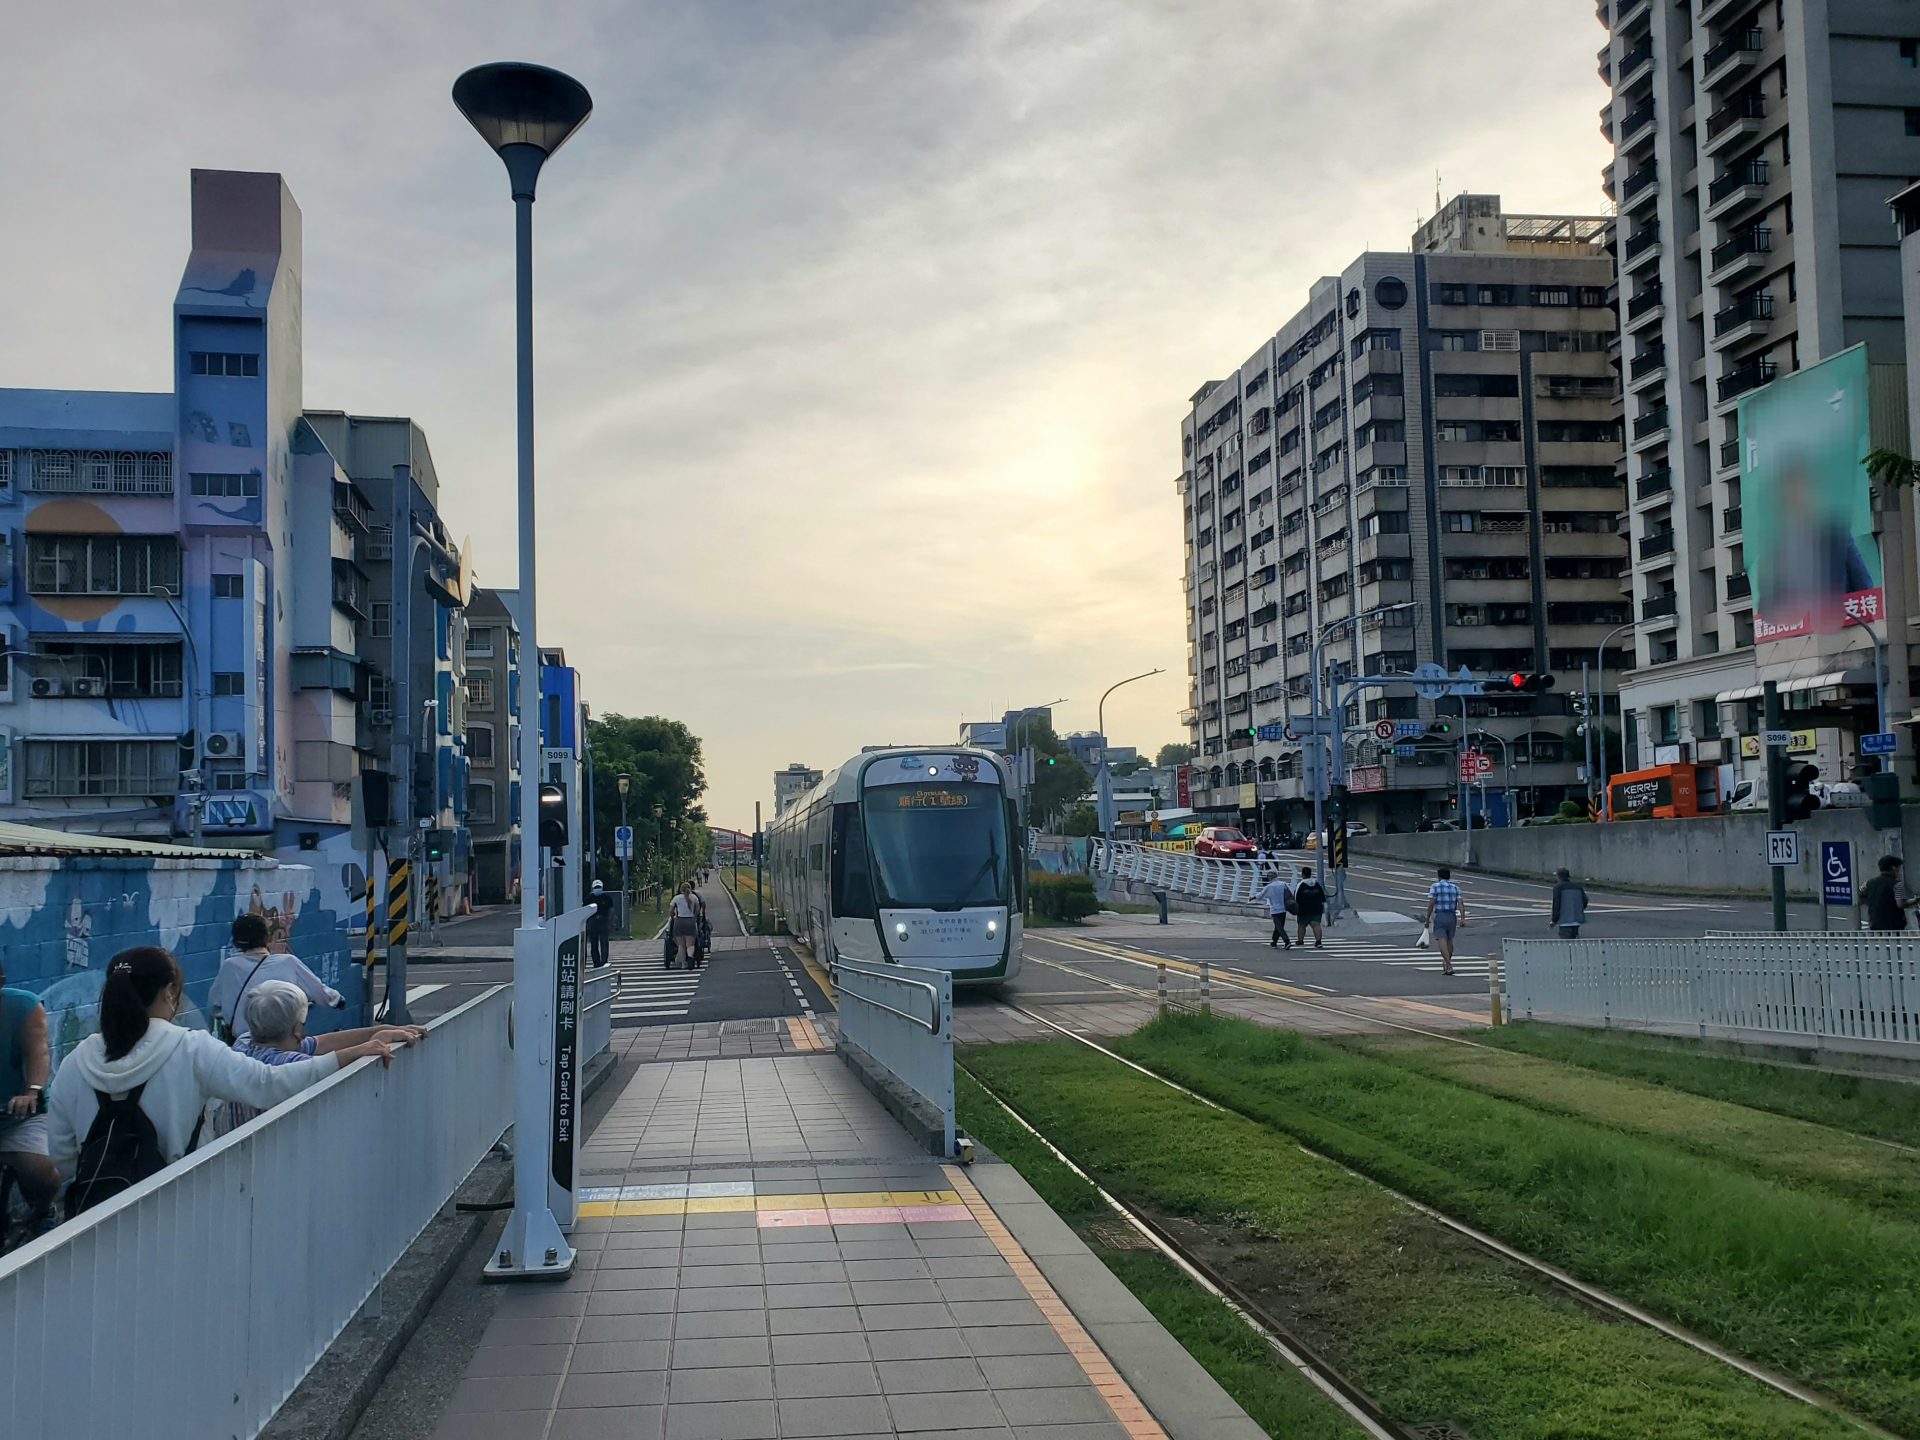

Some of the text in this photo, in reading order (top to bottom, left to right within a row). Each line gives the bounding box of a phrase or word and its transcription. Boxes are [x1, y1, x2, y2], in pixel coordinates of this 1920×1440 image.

[1843, 594, 1878, 620] 支持
[1767, 734, 1787, 742] S096
[547, 751, 568, 760] S099
[1623, 781, 1659, 795] KERRY
[1772, 837, 1793, 859] RTS
[559, 953, 575, 1031] 出站請刷卡
[559, 1045, 571, 1142] Tap Card to Exit
